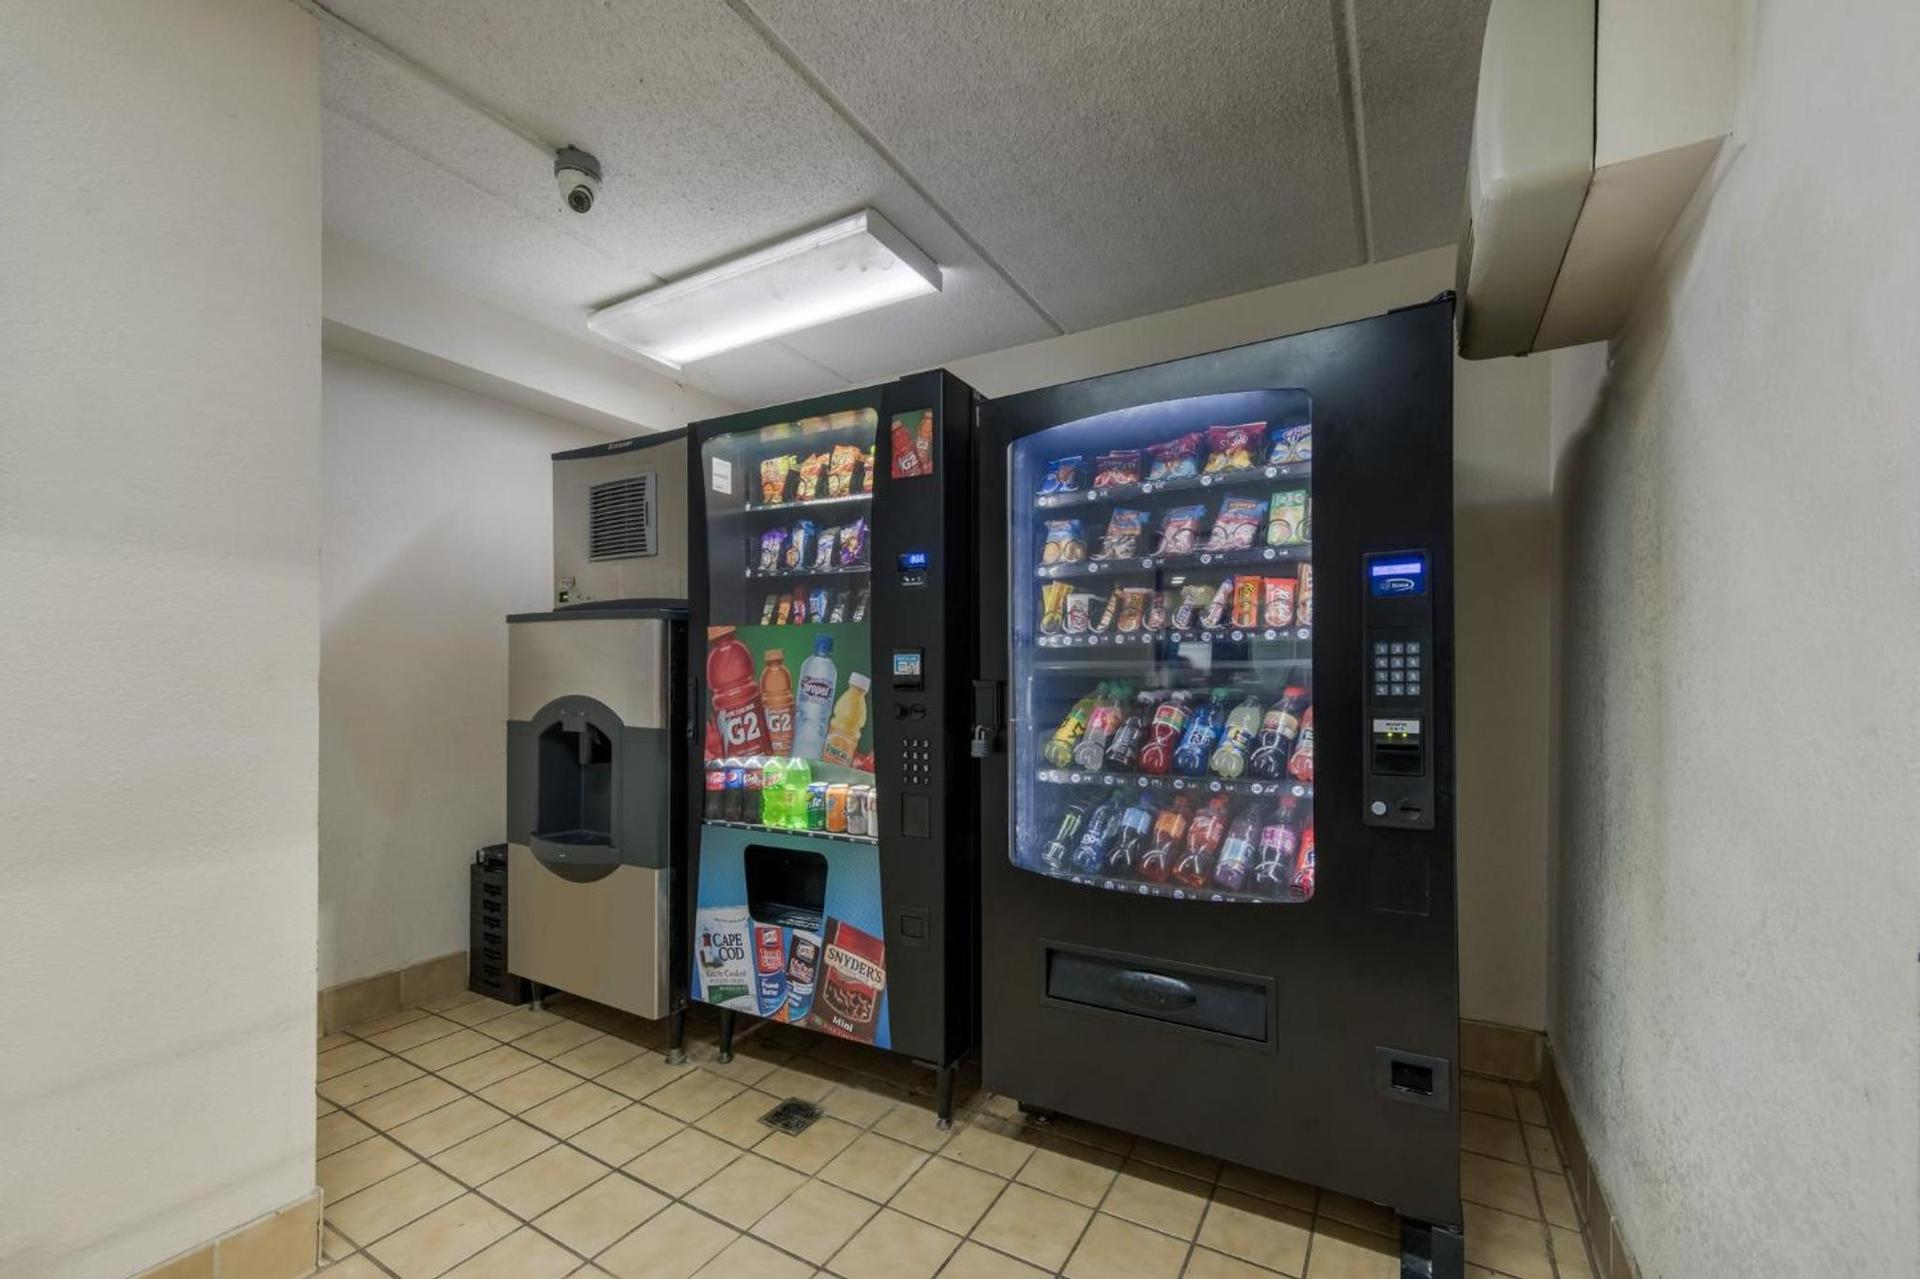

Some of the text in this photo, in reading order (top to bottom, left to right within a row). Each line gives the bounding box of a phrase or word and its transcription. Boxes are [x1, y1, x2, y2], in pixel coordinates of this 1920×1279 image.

[902, 454, 917, 470] G2
[803, 682, 831, 698] propel
[727, 711, 761, 745] G2
[768, 713, 792, 732] G2
[712, 932, 743, 947] CAPE
[718, 946, 745, 961] COD
[827, 947, 883, 984] SNYDER'S
[832, 1015, 854, 1033] Mini
